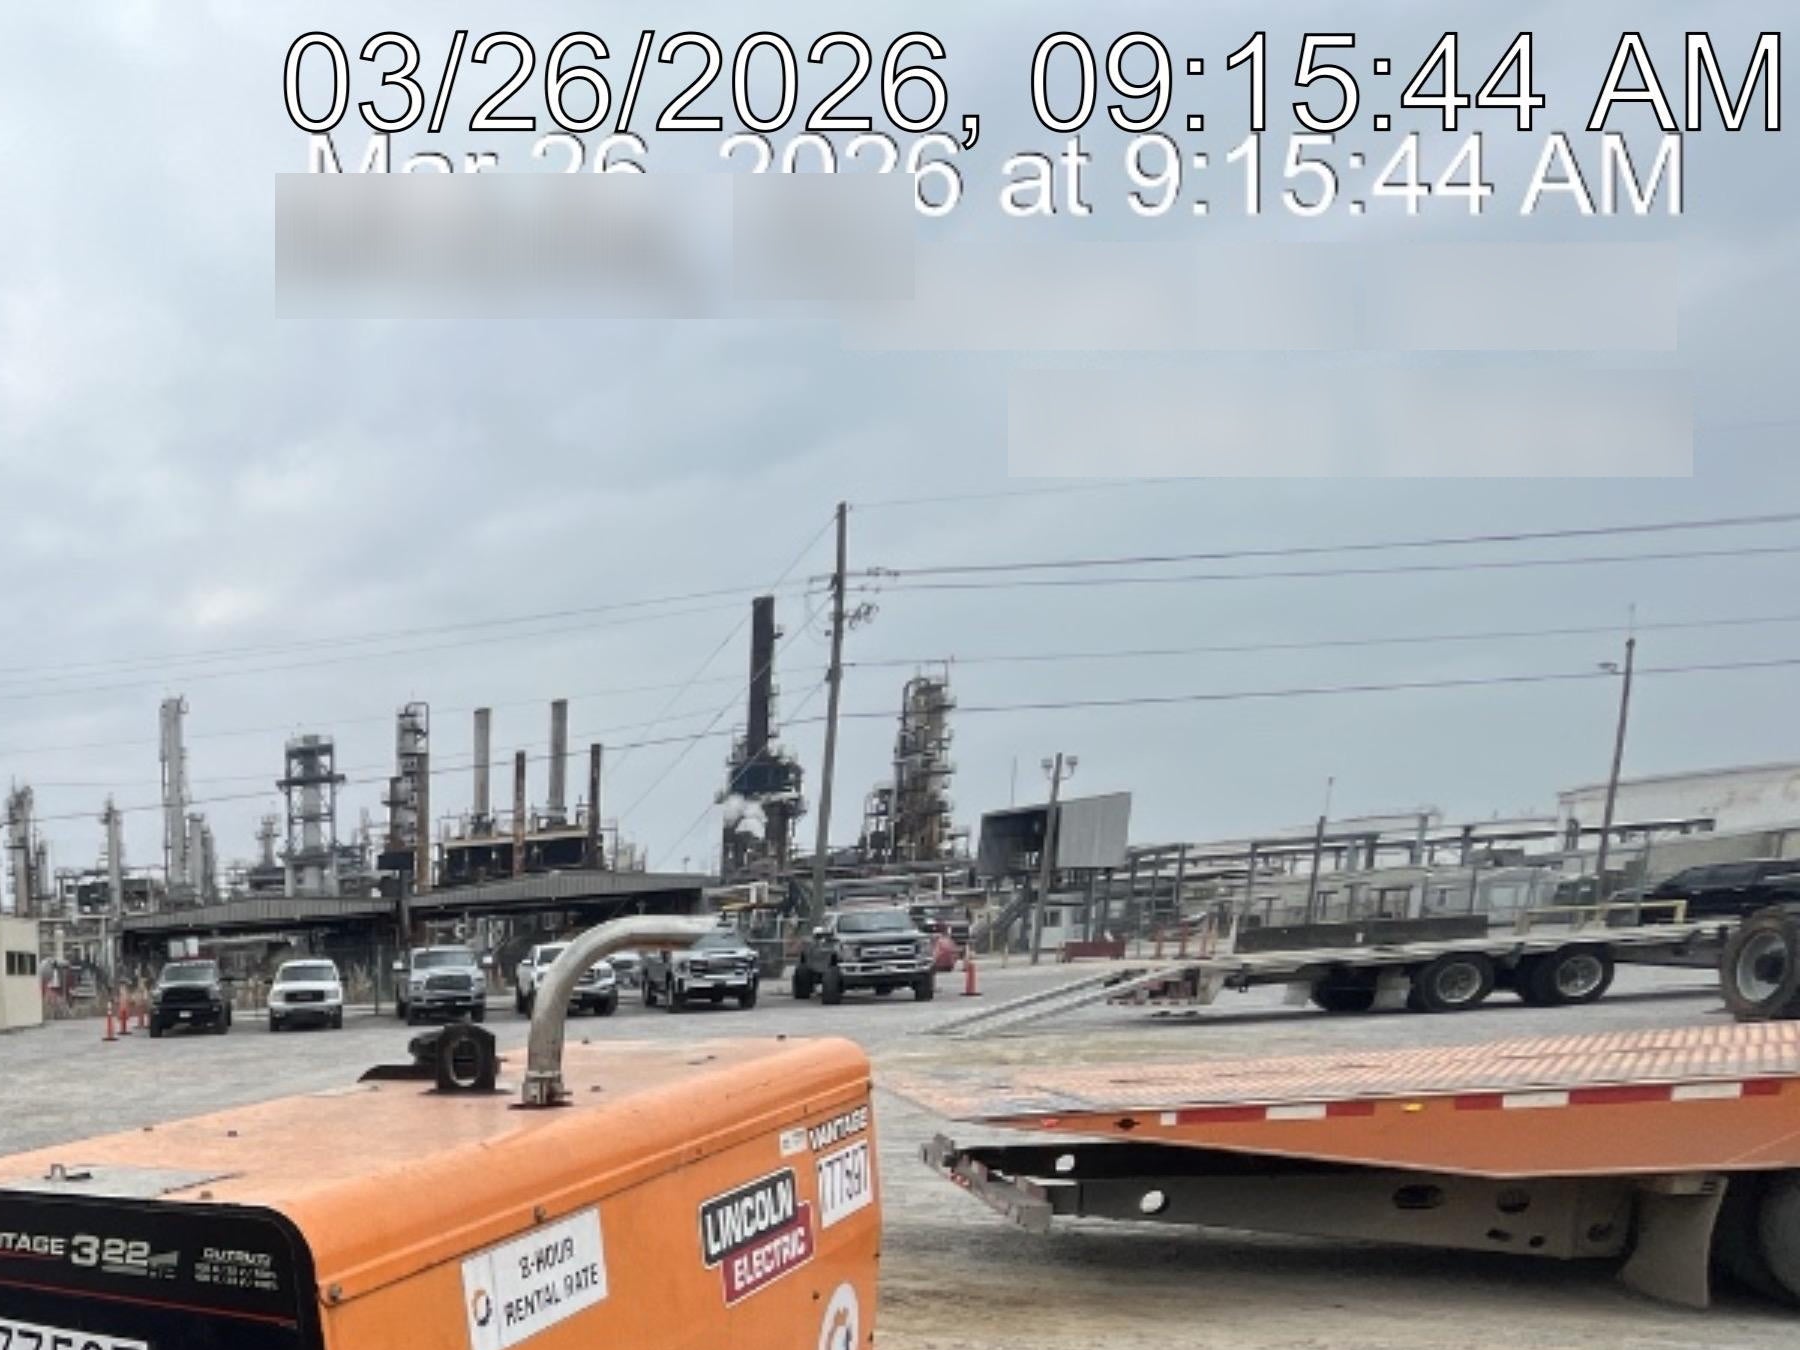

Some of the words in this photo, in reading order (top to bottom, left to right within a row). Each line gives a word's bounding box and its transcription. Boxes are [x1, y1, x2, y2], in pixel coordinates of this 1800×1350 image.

[706, 1177, 794, 1256] LINCOLN
[71, 1233, 150, 1267] 322
[518, 1236, 574, 1280] 8-HOUR
[734, 1226, 805, 1291] ELECTRIC
[504, 1280, 562, 1327] RENTAL
[564, 1262, 599, 1298] RATE
